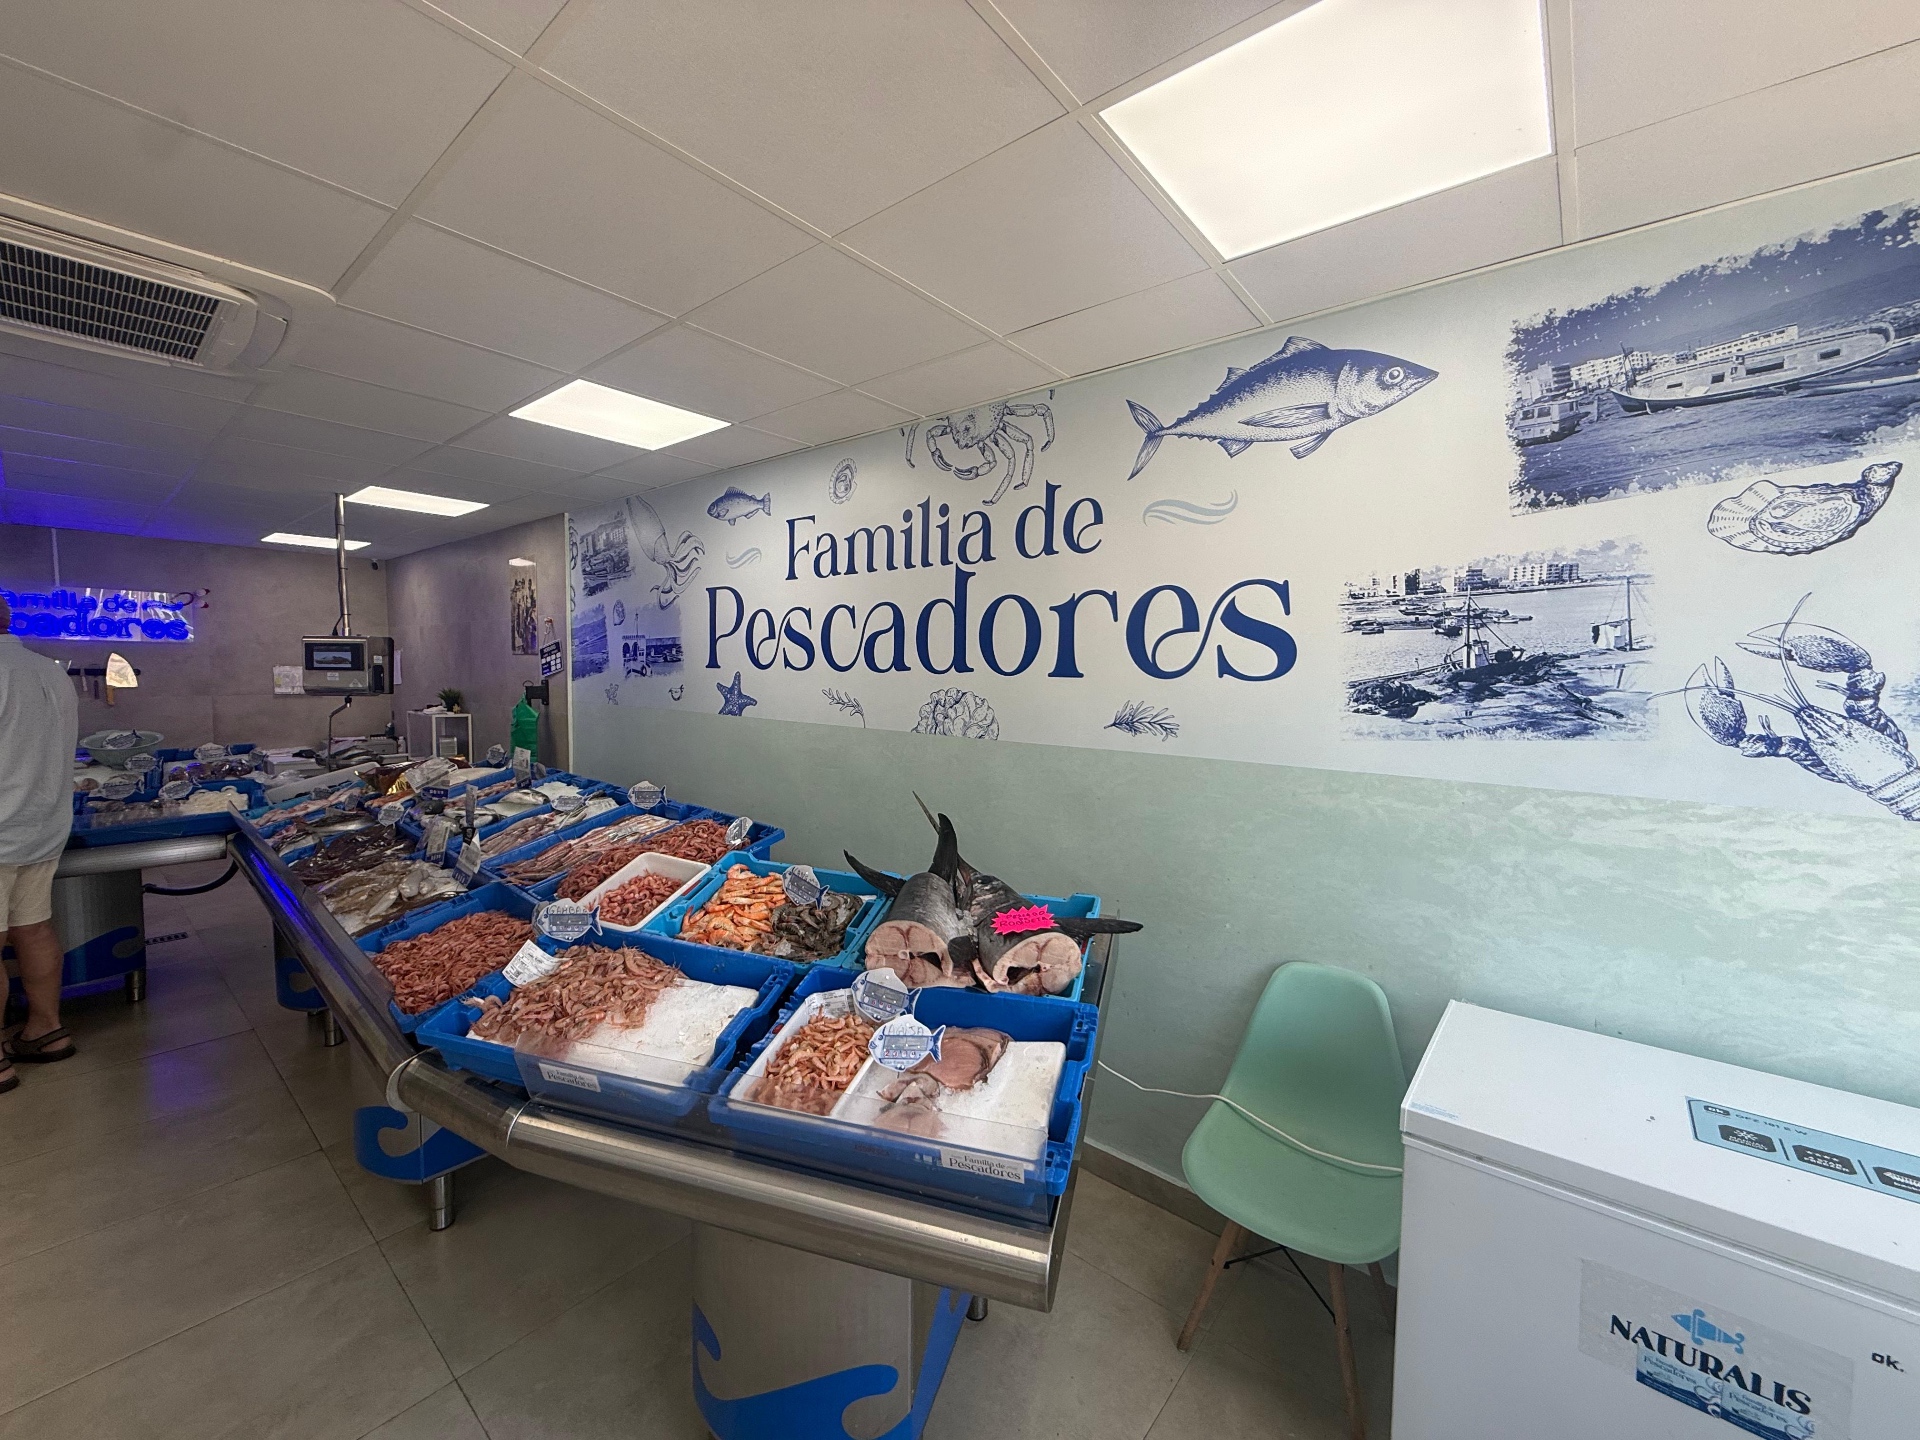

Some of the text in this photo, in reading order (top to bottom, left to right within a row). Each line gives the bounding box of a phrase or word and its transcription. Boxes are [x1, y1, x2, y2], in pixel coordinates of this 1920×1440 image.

[785, 479, 1103, 581] Familia de
[705, 564, 1298, 682] Pescadores
[949, 1157, 1021, 1180] Pescadores
[964, 1155, 995, 1167] Familia
[1609, 1314, 1812, 1415] NATURALIS
